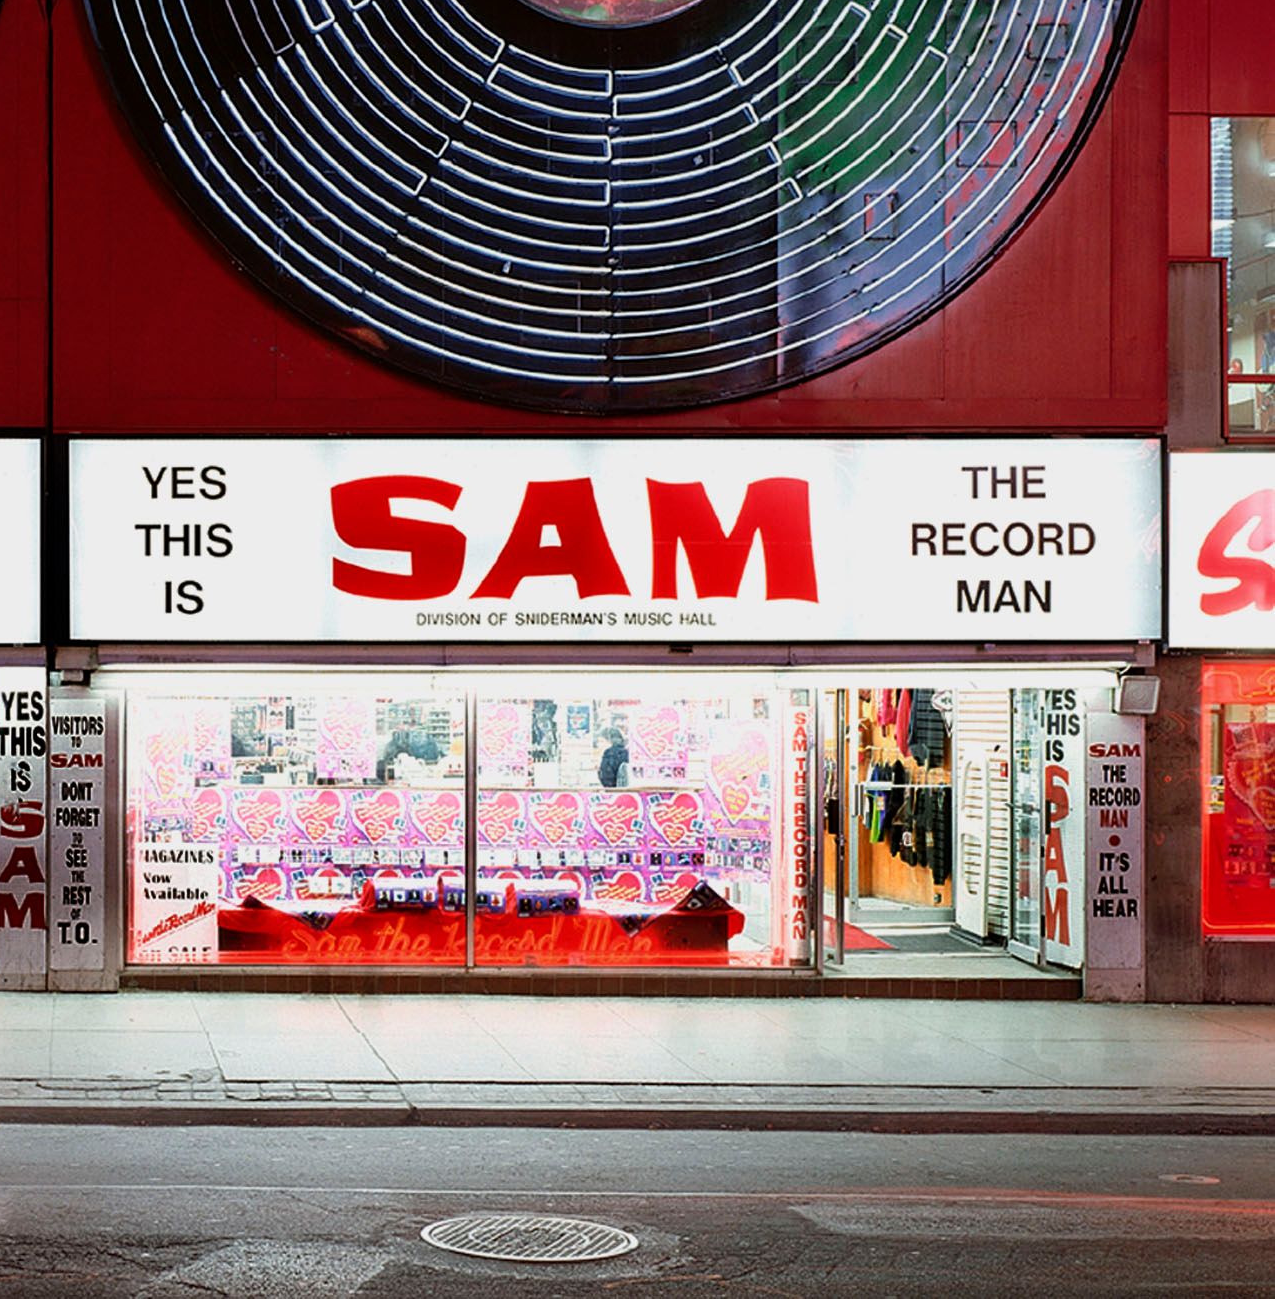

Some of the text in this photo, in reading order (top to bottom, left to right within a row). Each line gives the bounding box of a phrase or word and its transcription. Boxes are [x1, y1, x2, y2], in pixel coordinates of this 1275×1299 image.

[142, 465, 227, 501] YES
[961, 465, 1046, 499] THE
[134, 523, 234, 558] THIS
[330, 474, 820, 604] SAM
[911, 522, 1096, 557] RECORD
[164, 581, 204, 615] IS
[956, 579, 1052, 613] MAN
[416, 611, 716, 627] DIVISION OF SNIDERMAN'S MUSIC HALL
[1, 690, 44, 722] YES
[51, 715, 105, 736] VISITORS
[1046, 713, 1081, 737] HIS
[71, 736, 83, 749] TO
[1045, 739, 1065, 763] IS
[1088, 743, 1142, 759] SAM
[50, 753, 104, 768] SAM
[10, 760, 32, 793] IS
[1101, 764, 1128, 784] THE
[61, 781, 94, 802] DONT
[1089, 787, 1141, 807] RECORD
[55, 807, 100, 827] FORGET
[791, 712, 808, 941] SAM THE RECORD MAN
[1099, 809, 1129, 829] MAN
[65, 848, 88, 868] SEE
[1098, 852, 1131, 873] IT'S
[71, 870, 86, 883] THE
[1097, 876, 1129, 895] ALL
[62, 886, 93, 906] REST
[143, 887, 209, 900] Available
[1092, 898, 1139, 919] HEAR
[56, 921, 99, 944] T.O.
[376, 916, 431, 959] the
